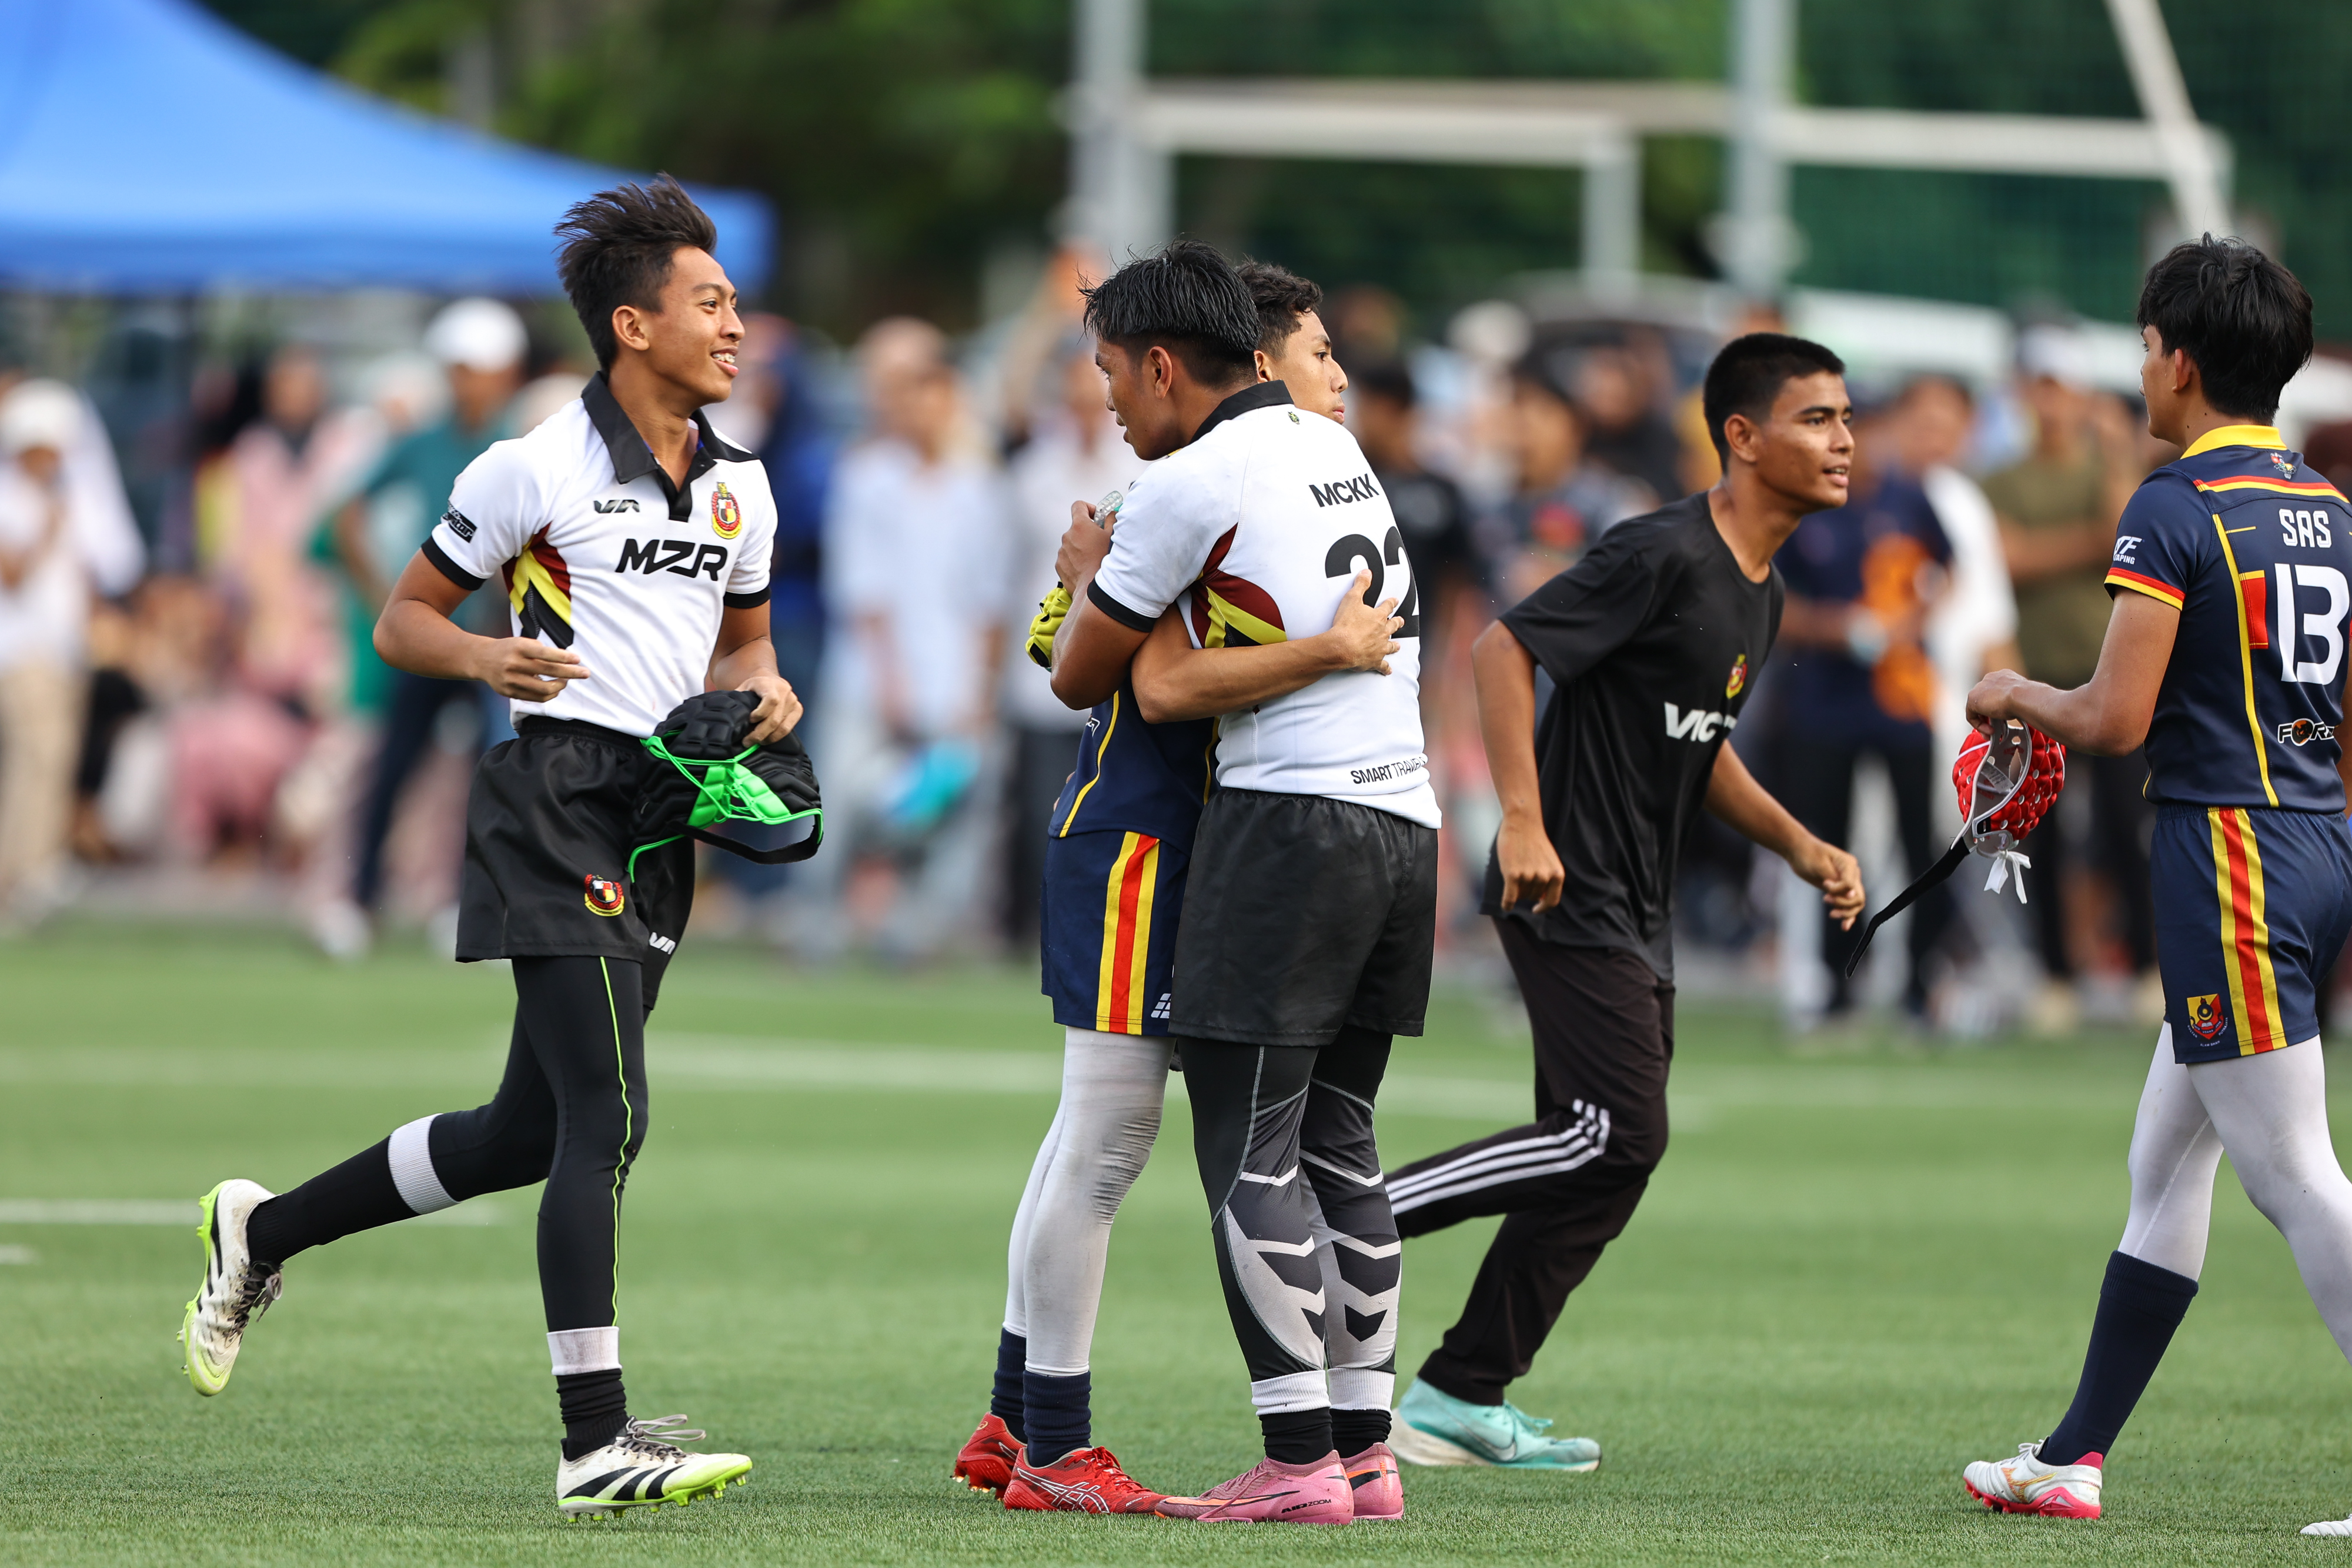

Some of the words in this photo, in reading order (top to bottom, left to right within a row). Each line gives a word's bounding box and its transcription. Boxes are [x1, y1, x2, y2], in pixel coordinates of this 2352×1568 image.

[1308, 473, 1379, 507] MCKK
[2279, 509, 2332, 548] SAS
[1325, 526, 1420, 639] 22
[2274, 563, 2350, 685] 13
[1351, 764, 1392, 784] SMART
[2187, 1025, 2197, 1038] SULTAN
[1281, 1503, 1307, 1513] AIR
